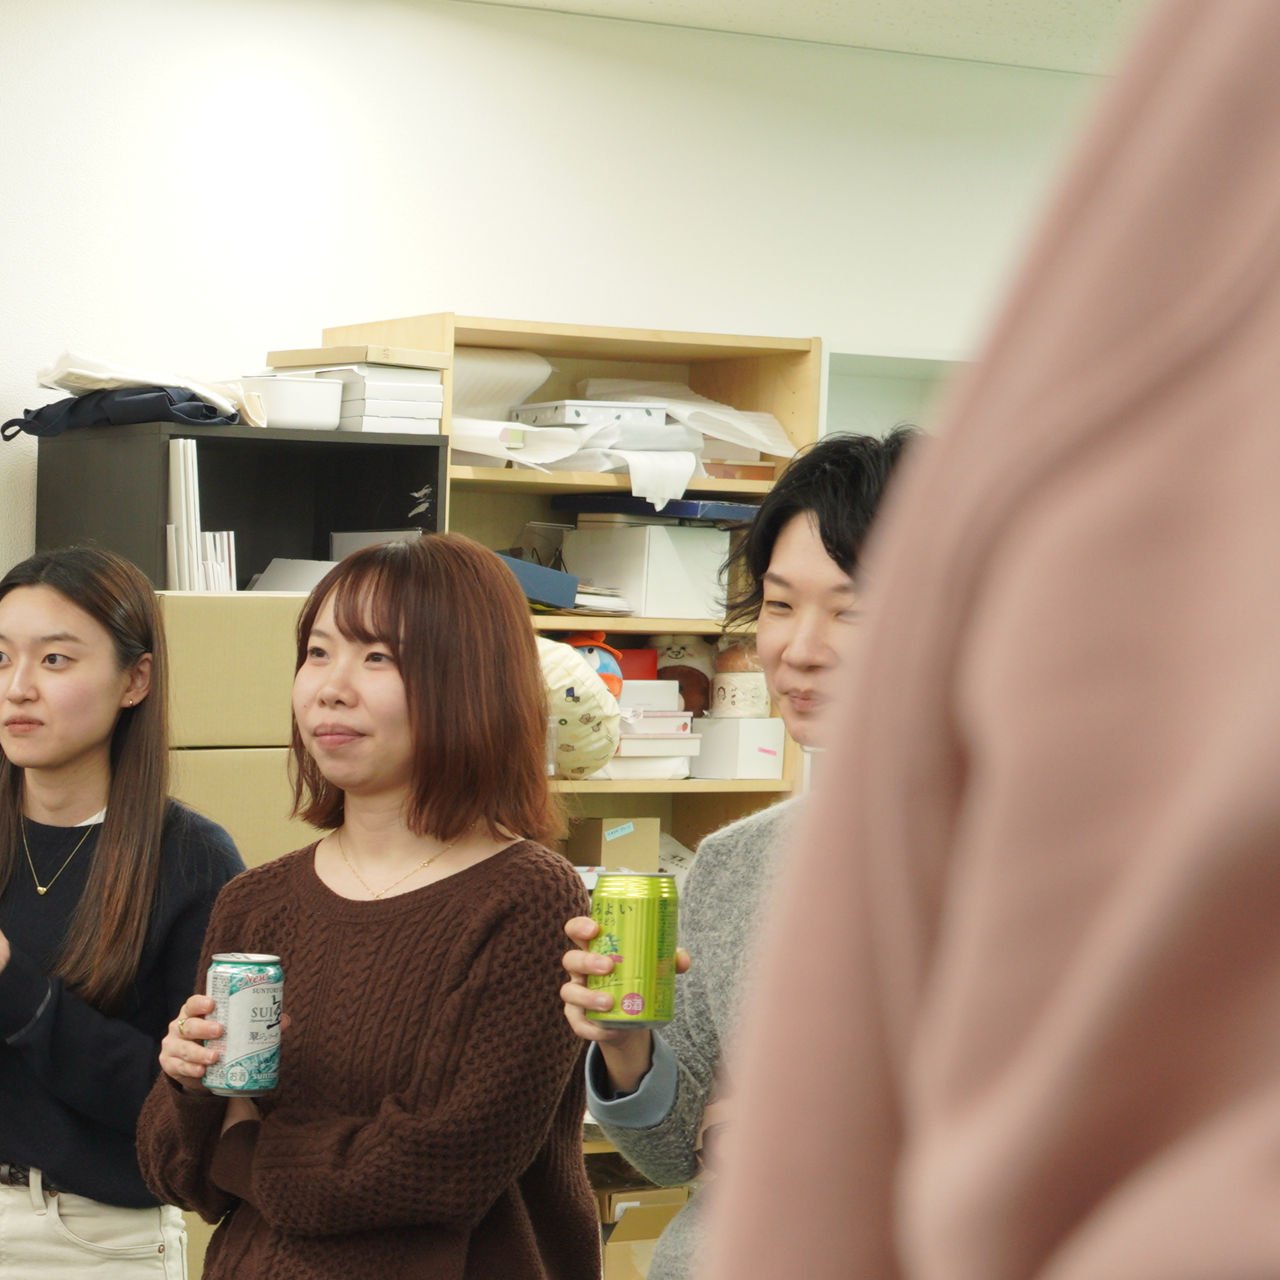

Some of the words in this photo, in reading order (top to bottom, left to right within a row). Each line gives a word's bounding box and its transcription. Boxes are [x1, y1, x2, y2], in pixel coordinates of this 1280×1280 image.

[238, 971, 269, 986] New
[623, 999, 642, 1011] お酒
[251, 1007, 273, 1018] SUI
[230, 1069, 246, 1082] お酒
